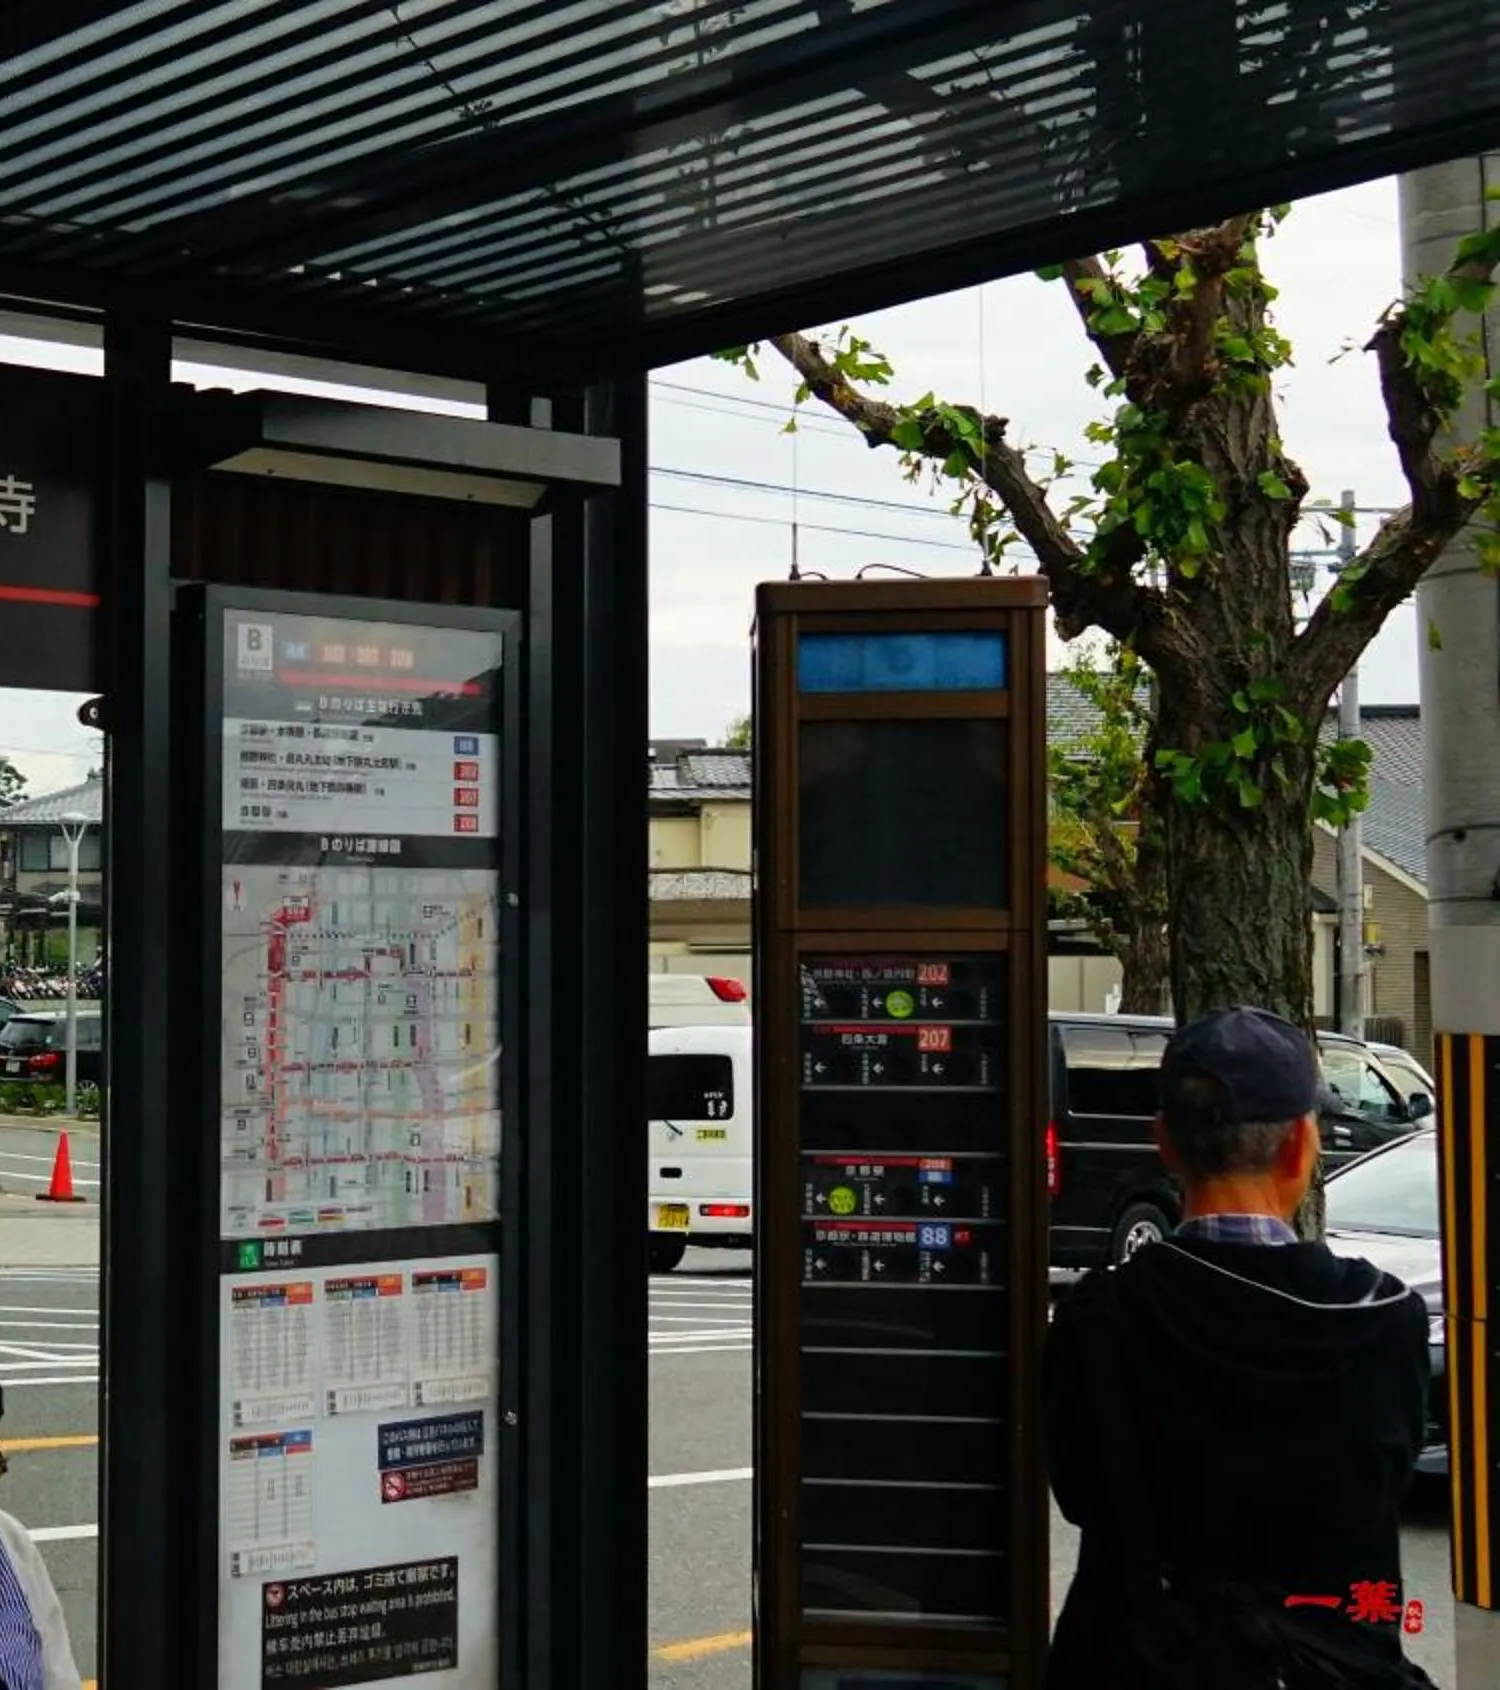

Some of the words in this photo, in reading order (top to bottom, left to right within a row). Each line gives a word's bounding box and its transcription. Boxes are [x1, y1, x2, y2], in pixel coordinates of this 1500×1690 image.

[247, 628, 262, 651] B
[918, 964, 948, 983] 202
[918, 1029, 950, 1048] 207
[921, 1227, 948, 1245] 88
[324, 1606, 339, 1620] bus
